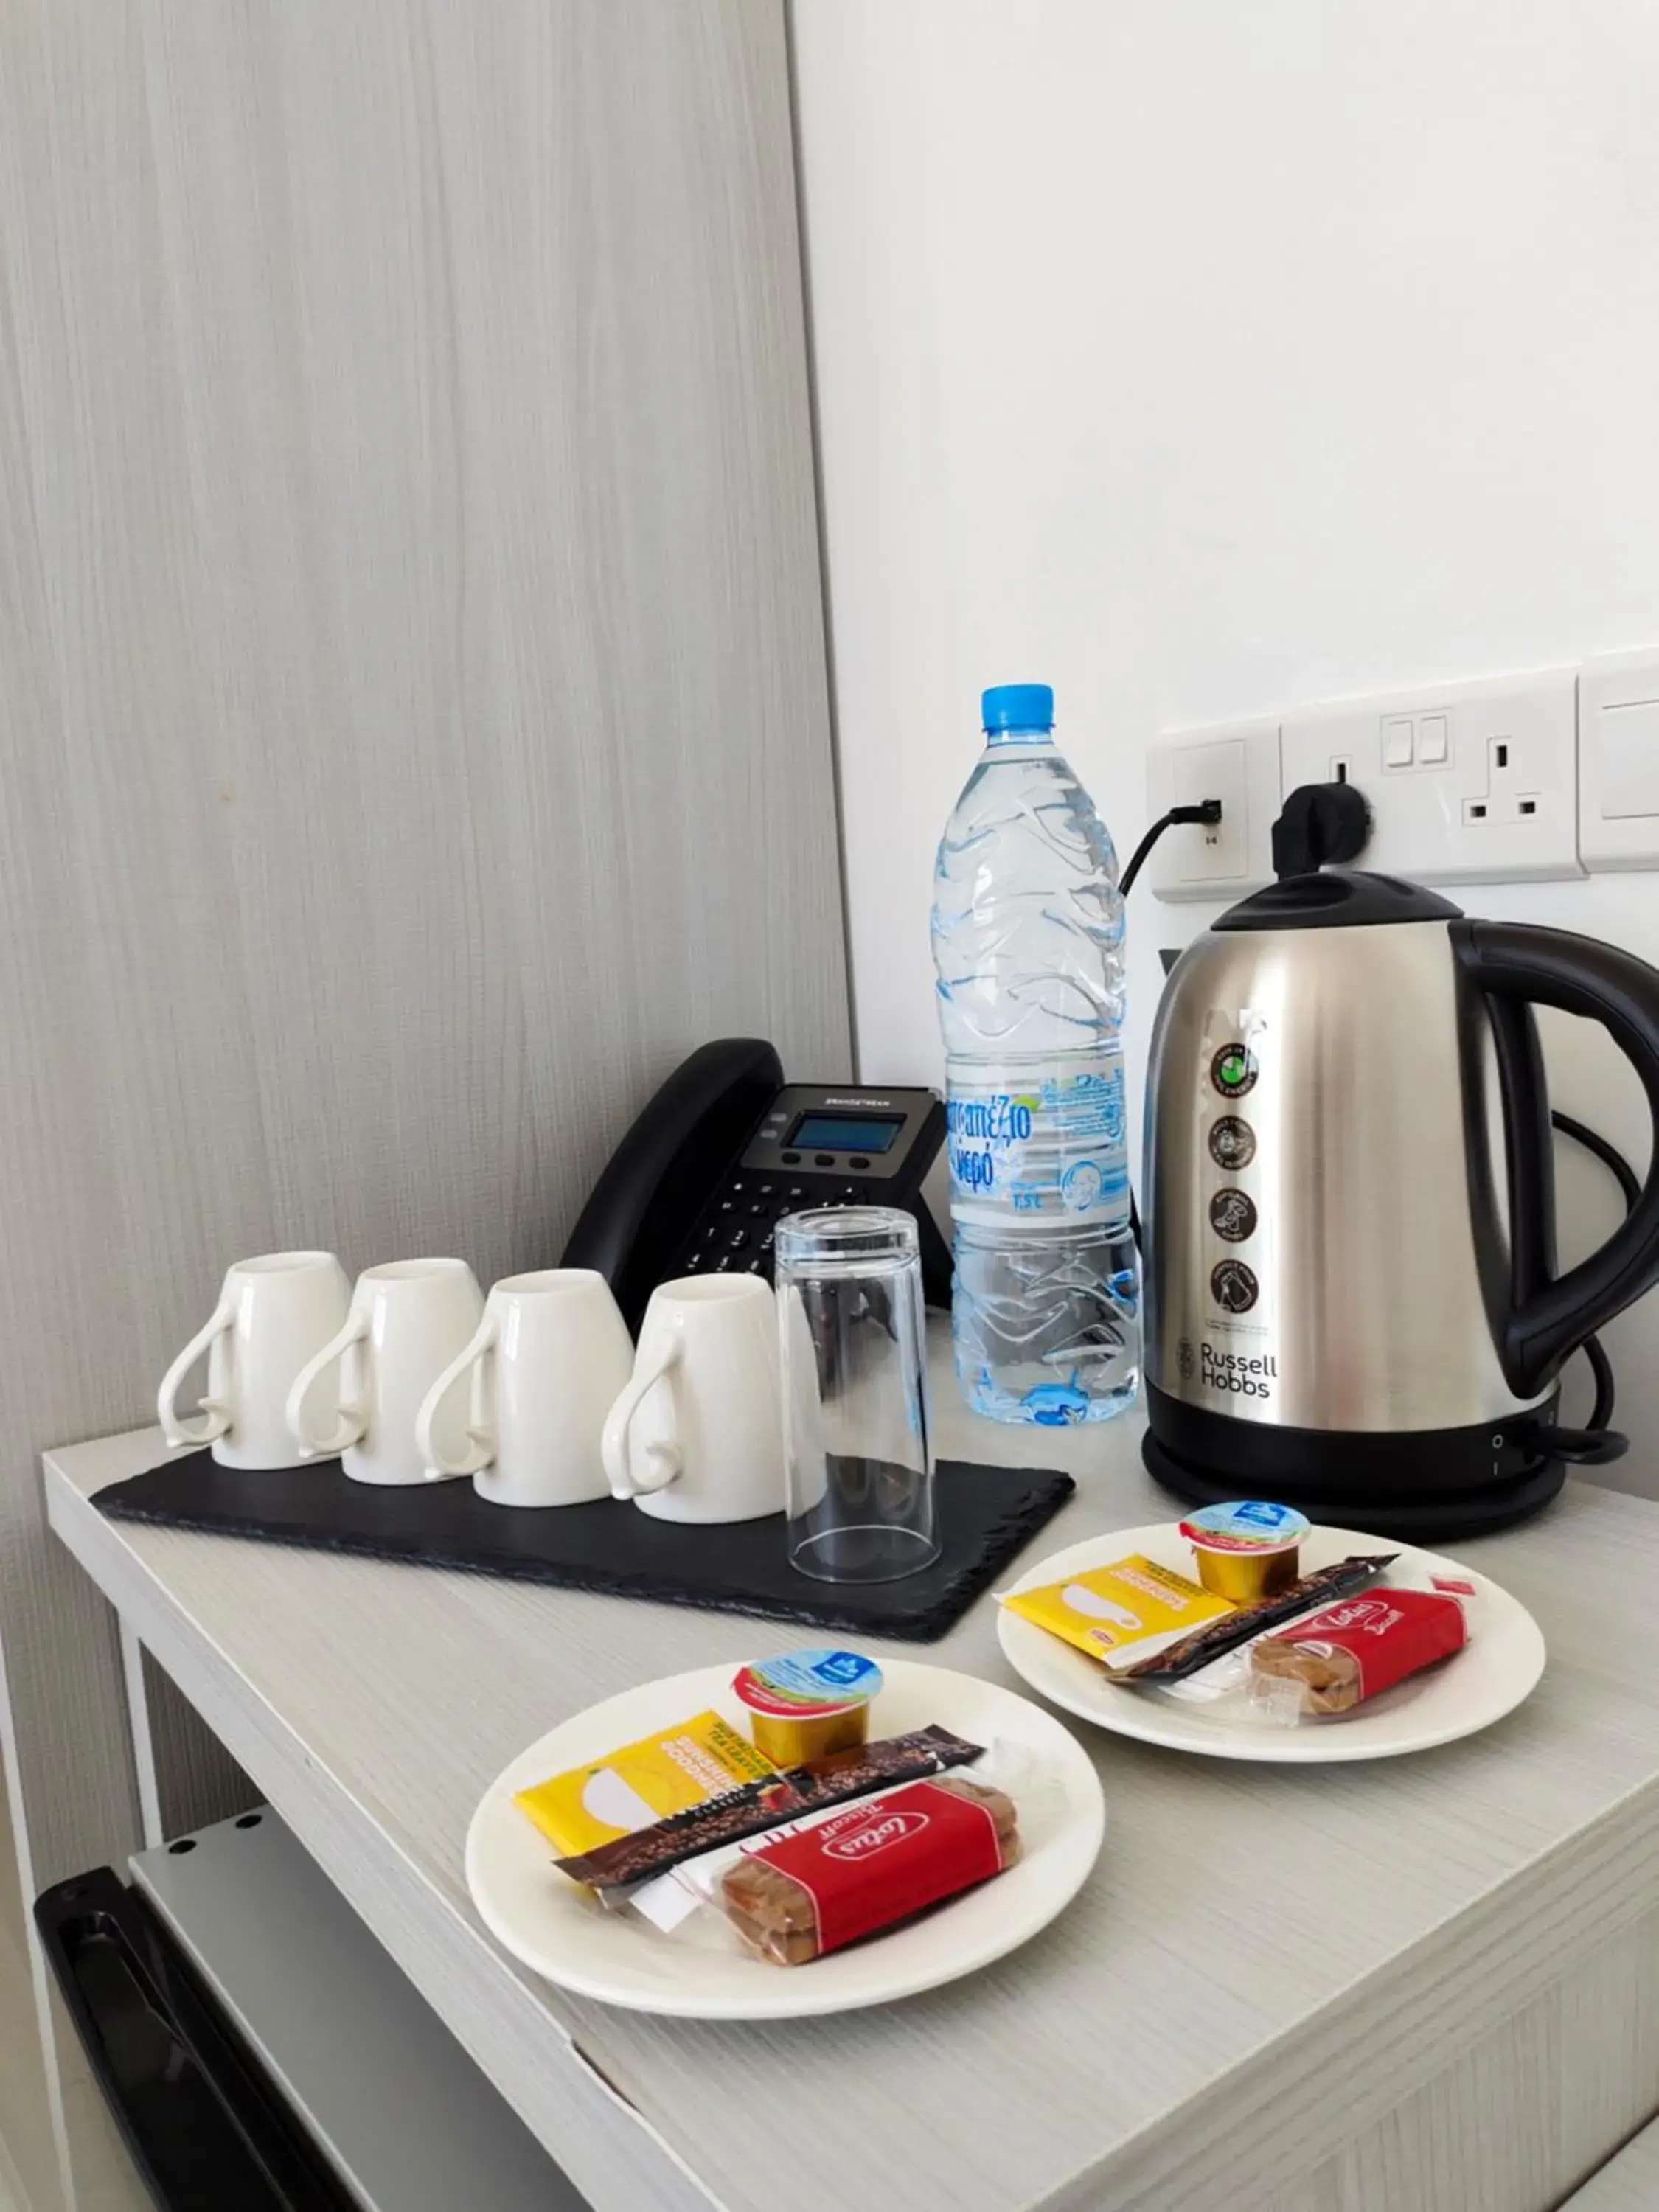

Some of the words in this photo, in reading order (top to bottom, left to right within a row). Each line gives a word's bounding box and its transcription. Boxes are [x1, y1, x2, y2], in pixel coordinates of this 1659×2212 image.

[1200, 1342, 1278, 1377] Russell
[1201, 1366, 1270, 1399] Hobbs
[839, 1817, 906, 1854] Lotus
